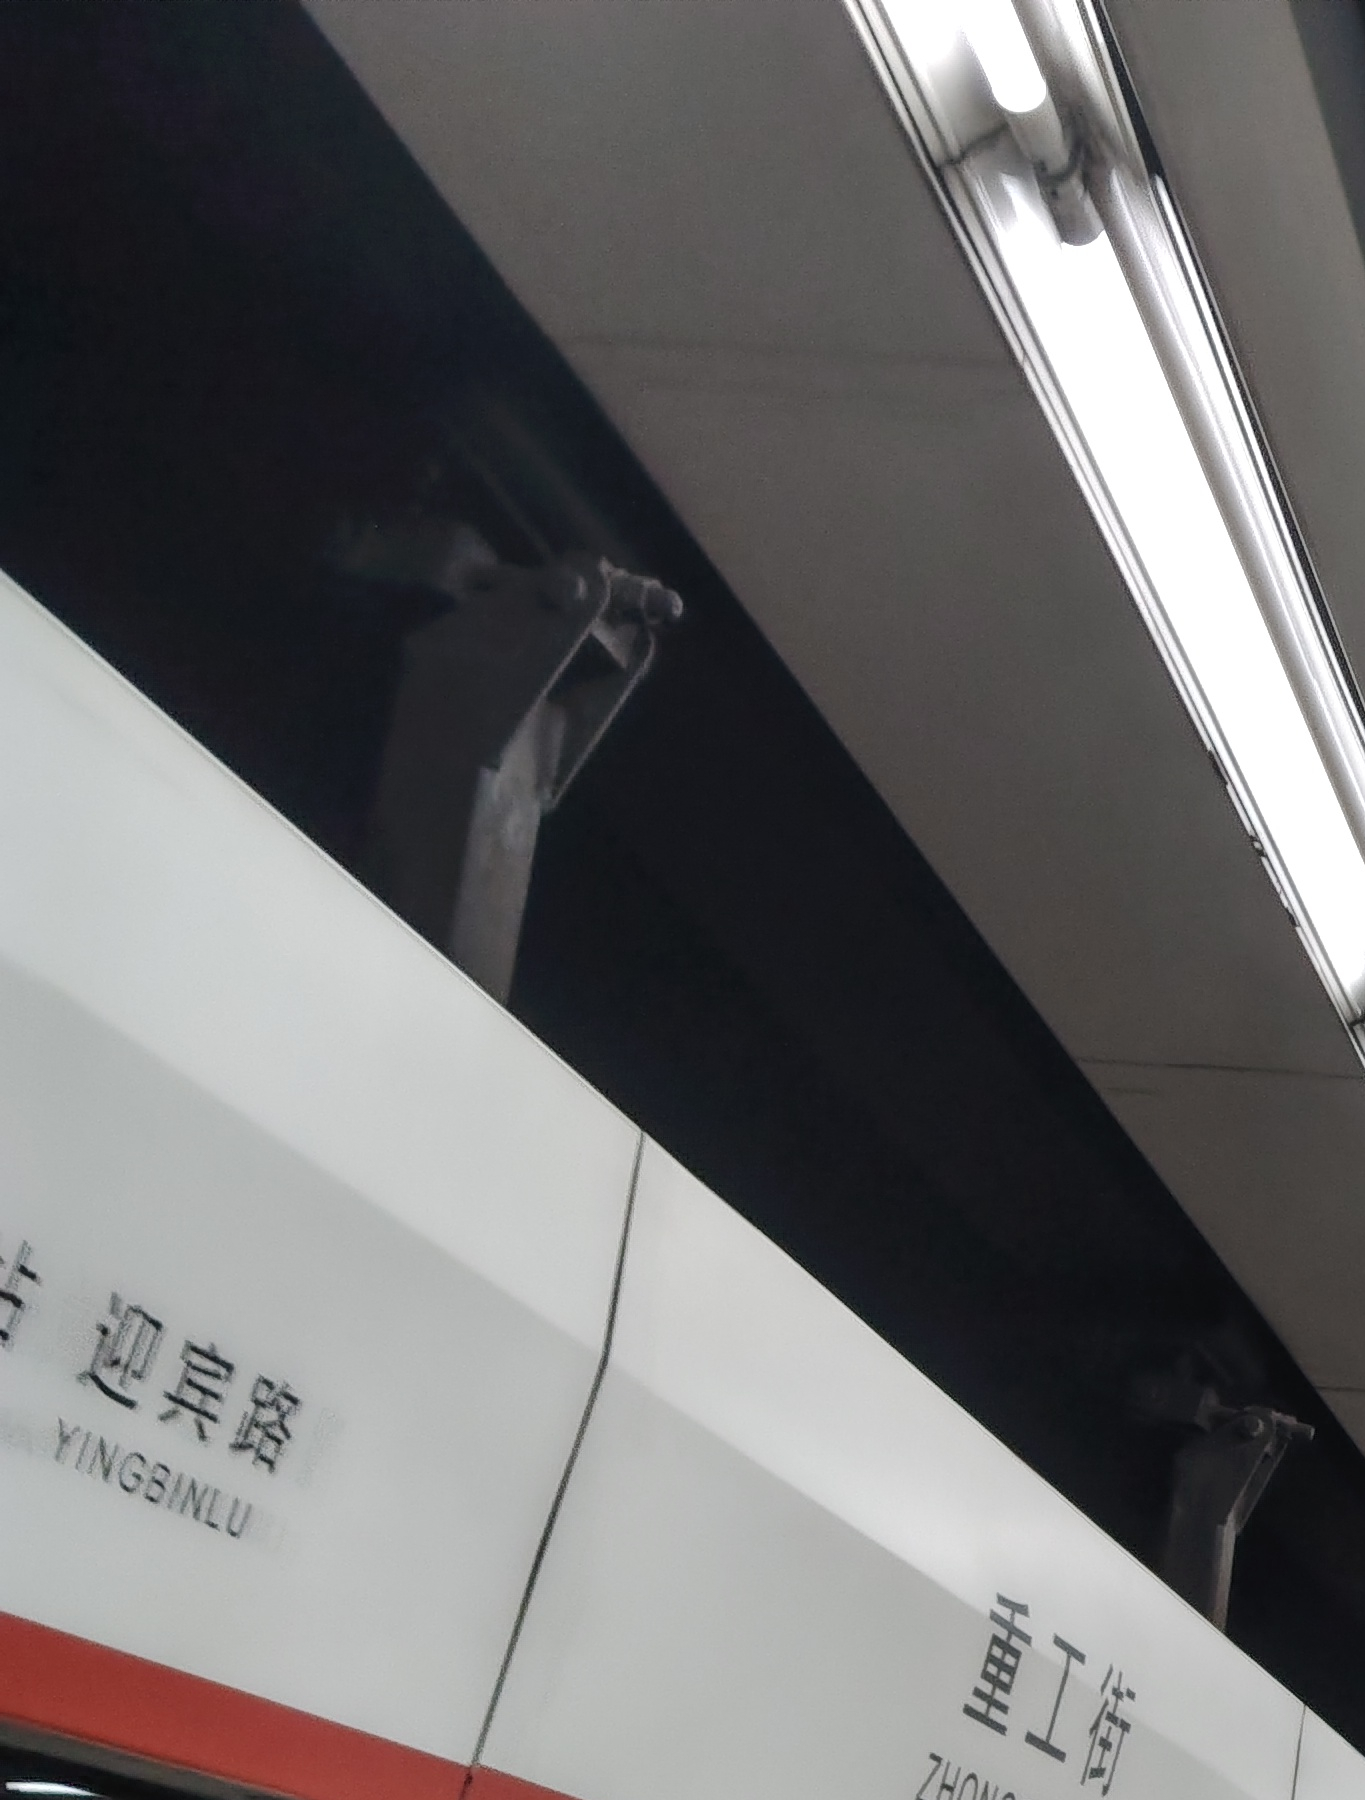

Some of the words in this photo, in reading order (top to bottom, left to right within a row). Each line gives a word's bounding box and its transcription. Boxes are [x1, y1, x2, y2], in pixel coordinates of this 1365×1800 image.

[76, 1291, 303, 1474] 迎宾路
[56, 1416, 253, 1539] YINGBINLU
[962, 1592, 1136, 1797] 重工街
